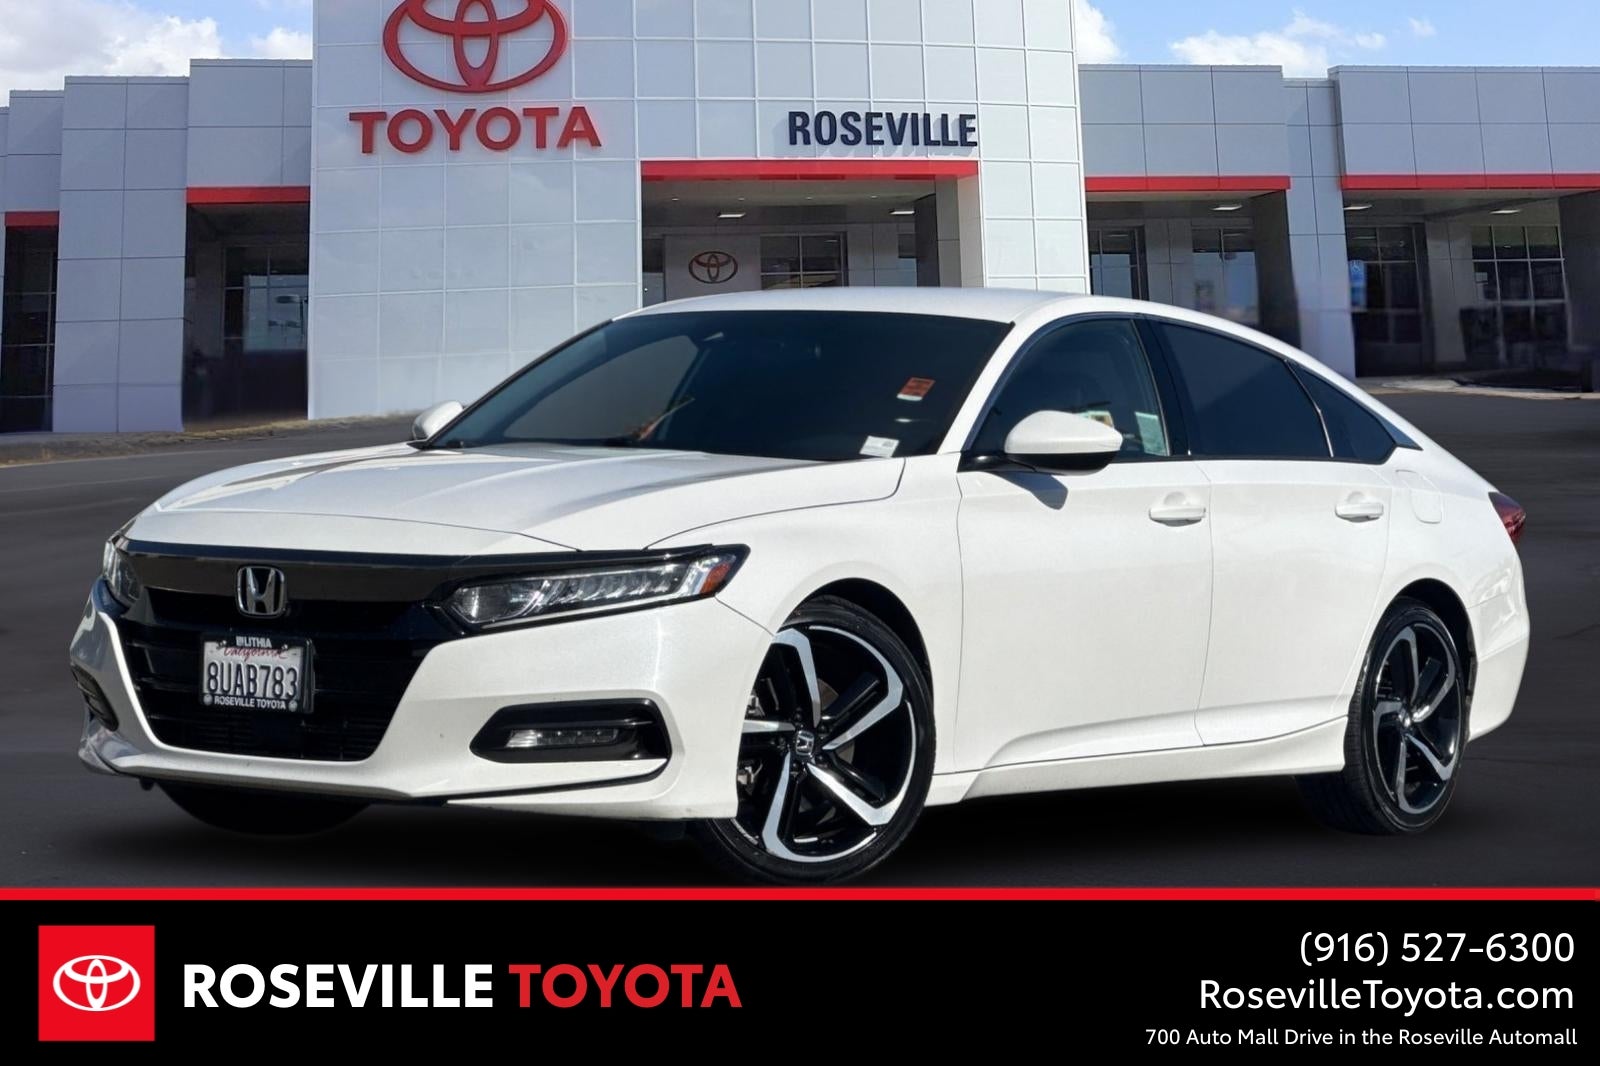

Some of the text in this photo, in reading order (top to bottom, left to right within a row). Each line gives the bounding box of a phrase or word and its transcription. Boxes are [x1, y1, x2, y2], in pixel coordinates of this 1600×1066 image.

[349, 106, 602, 154] TOYOTA
[788, 111, 978, 147] ROSEVILLE
[207, 661, 298, 700] 8UAB783
[214, 695, 287, 710] ROSEVILLE TOYOTA
